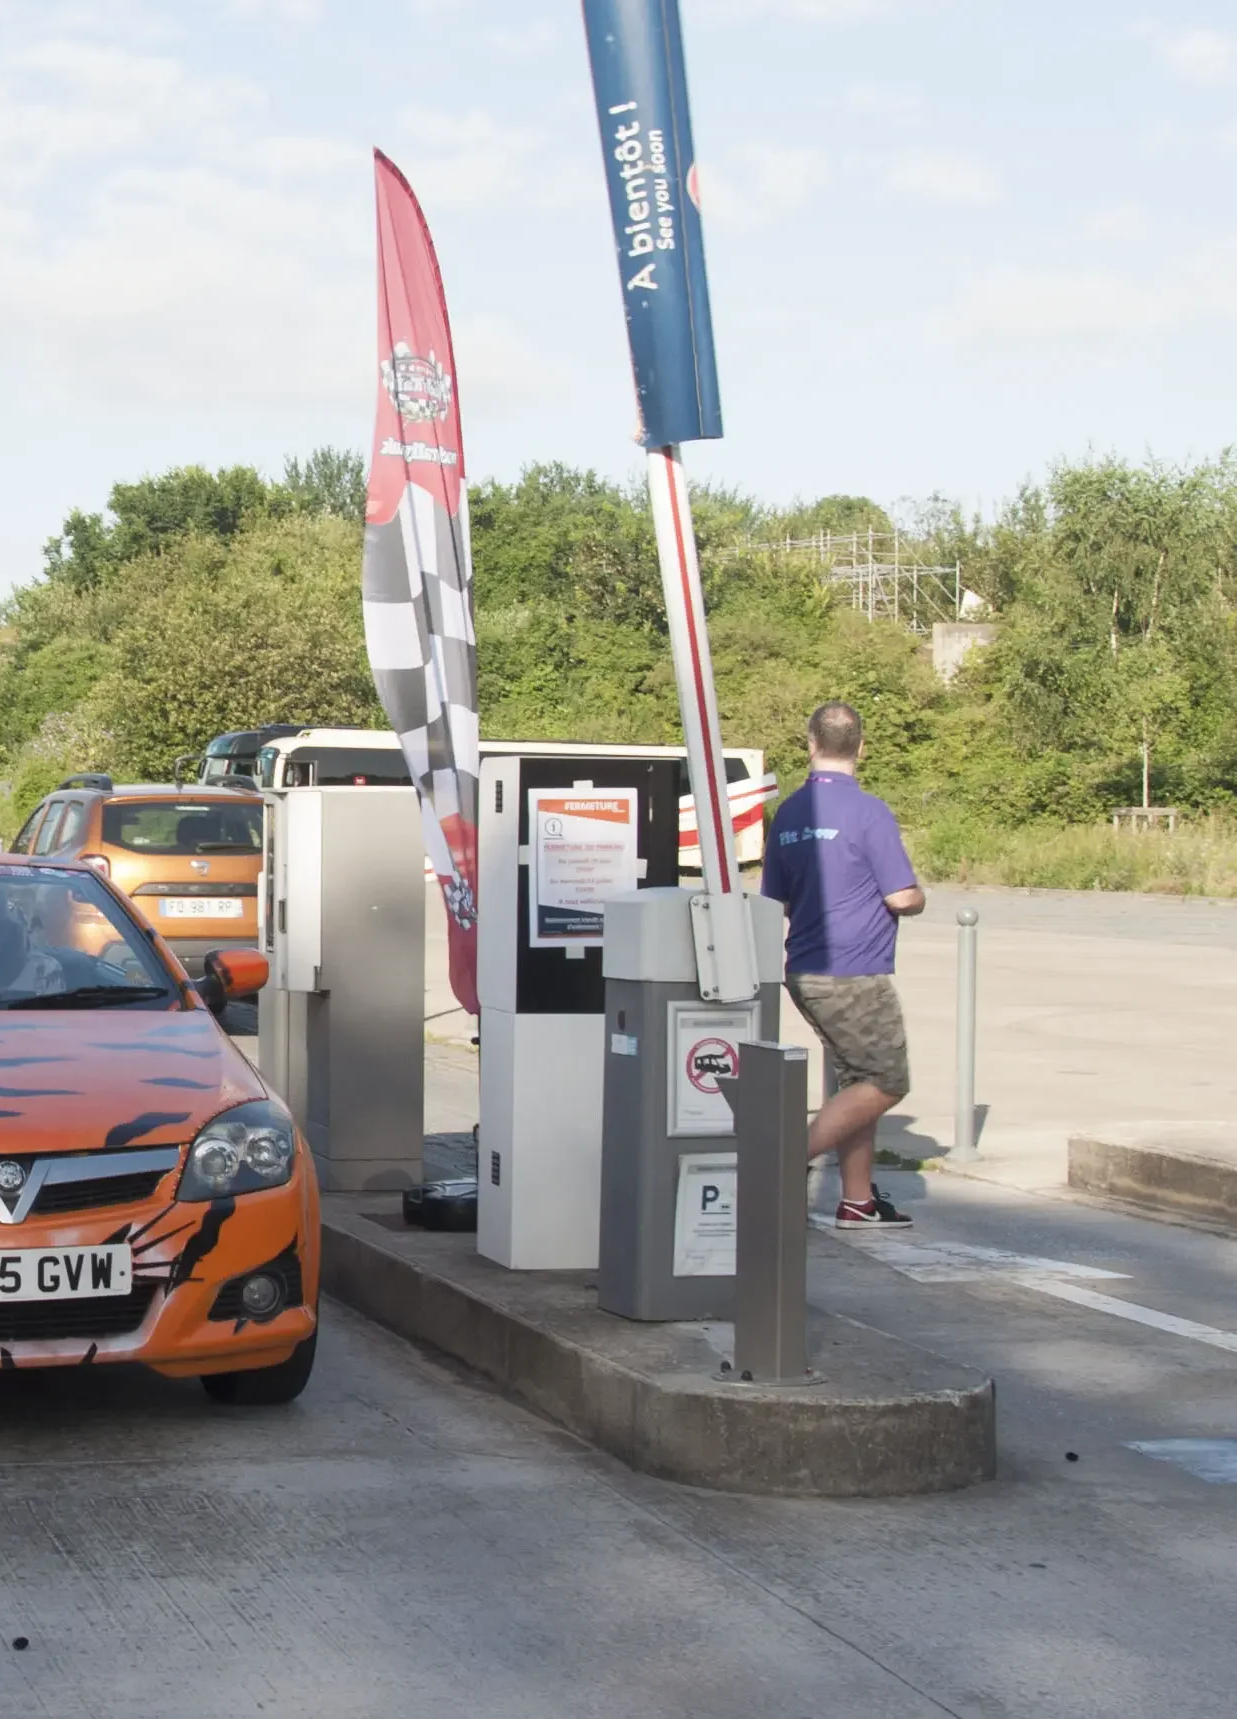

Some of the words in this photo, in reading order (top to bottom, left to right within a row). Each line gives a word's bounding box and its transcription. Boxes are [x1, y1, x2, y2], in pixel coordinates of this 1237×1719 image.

[647, 129, 667, 173] soon
[653, 178, 676, 212] you
[656, 216, 676, 251] See
[563, 800, 620, 812] FERMETURE
[701, 1184, 720, 1211] P
[37, 1252, 113, 1293] GVW
